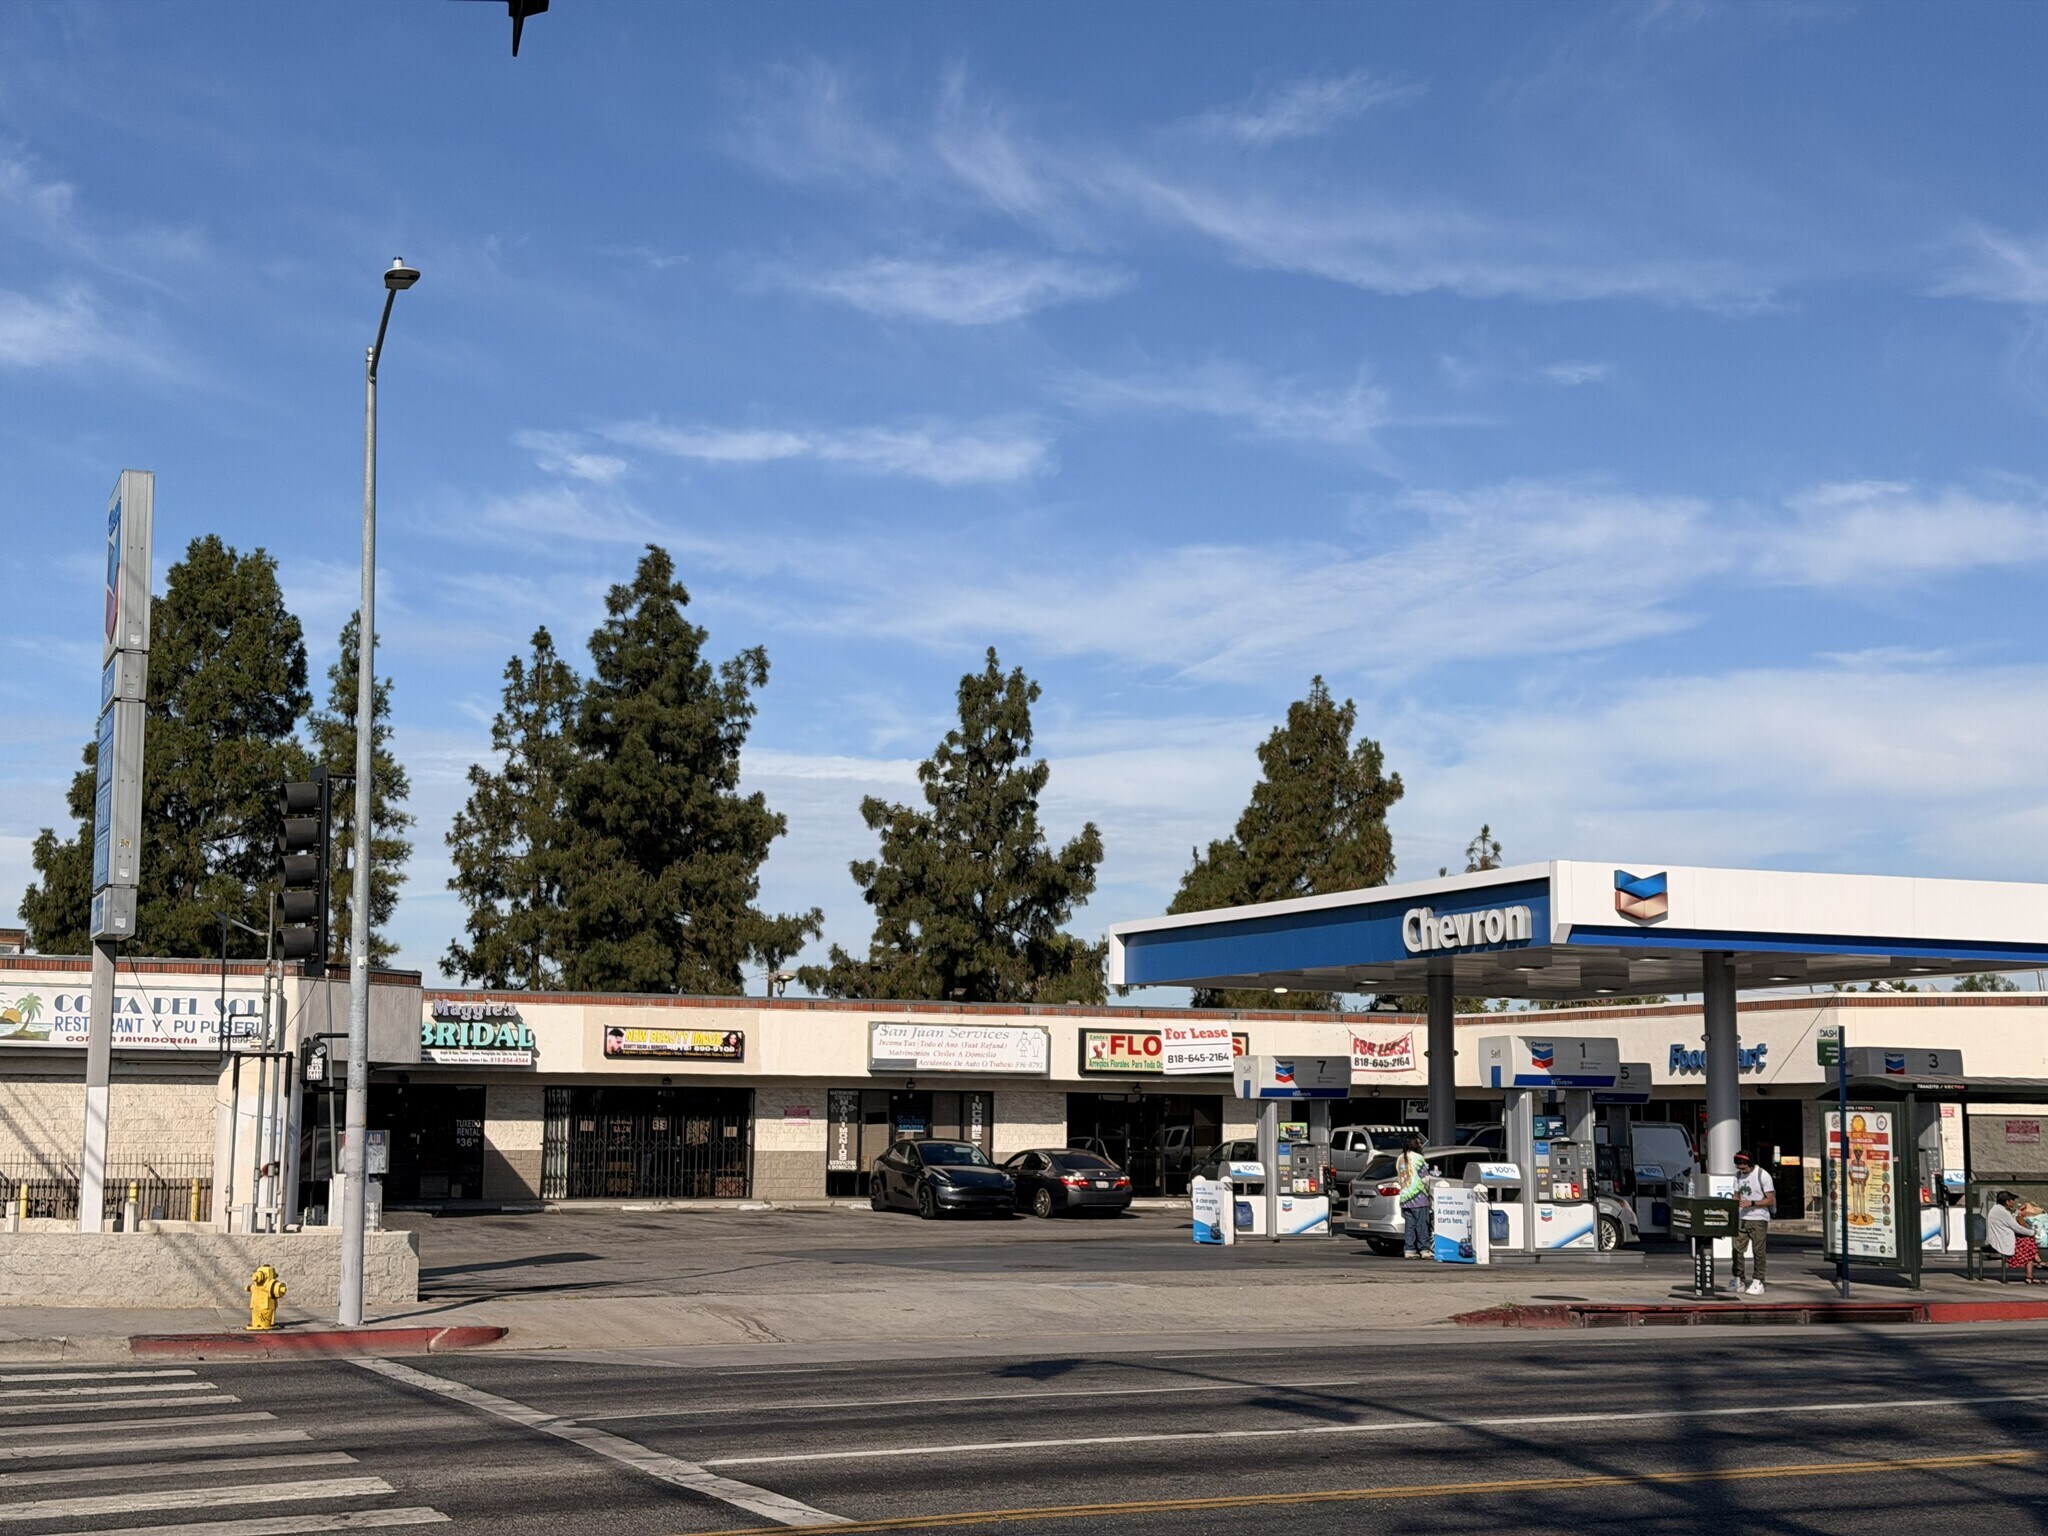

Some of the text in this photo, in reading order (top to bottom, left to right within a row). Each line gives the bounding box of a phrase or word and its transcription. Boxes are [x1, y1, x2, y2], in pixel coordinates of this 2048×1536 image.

[1402, 906, 1532, 952] Chevron
[54, 994, 143, 1014] COTA
[153, 997, 204, 1015] DEL
[433, 999, 518, 1021] Maggie's
[54, 1016, 145, 1033] RESTANT
[152, 1020, 163, 1033] Y
[421, 1021, 535, 1047] BRIDAL
[624, 1029, 723, 1046] NEW BEAUTY IMAGE
[879, 1025, 1010, 1040] San Juan Services
[1164, 1027, 1229, 1040] For Lease
[1819, 1029, 1838, 1038] DASH
[1353, 1036, 1411, 1057] FOR LEASE
[1579, 1042, 1587, 1059] 1
[1167, 1052, 1230, 1064] 818-645-2164
[1354, 1056, 1411, 1068] 818-645-2164
[1669, 1043, 1769, 1069] Foo art
[1928, 1053, 1940, 1069] 3
[1317, 1060, 1328, 1074] 7
[1620, 1067, 1630, 1080] 5
[456, 1119, 481, 1128] TUXEDO
[456, 1127, 480, 1136] RENTAL
[1494, 1166, 1516, 1174] 100%
[1443, 1208, 1456, 1216] clean
